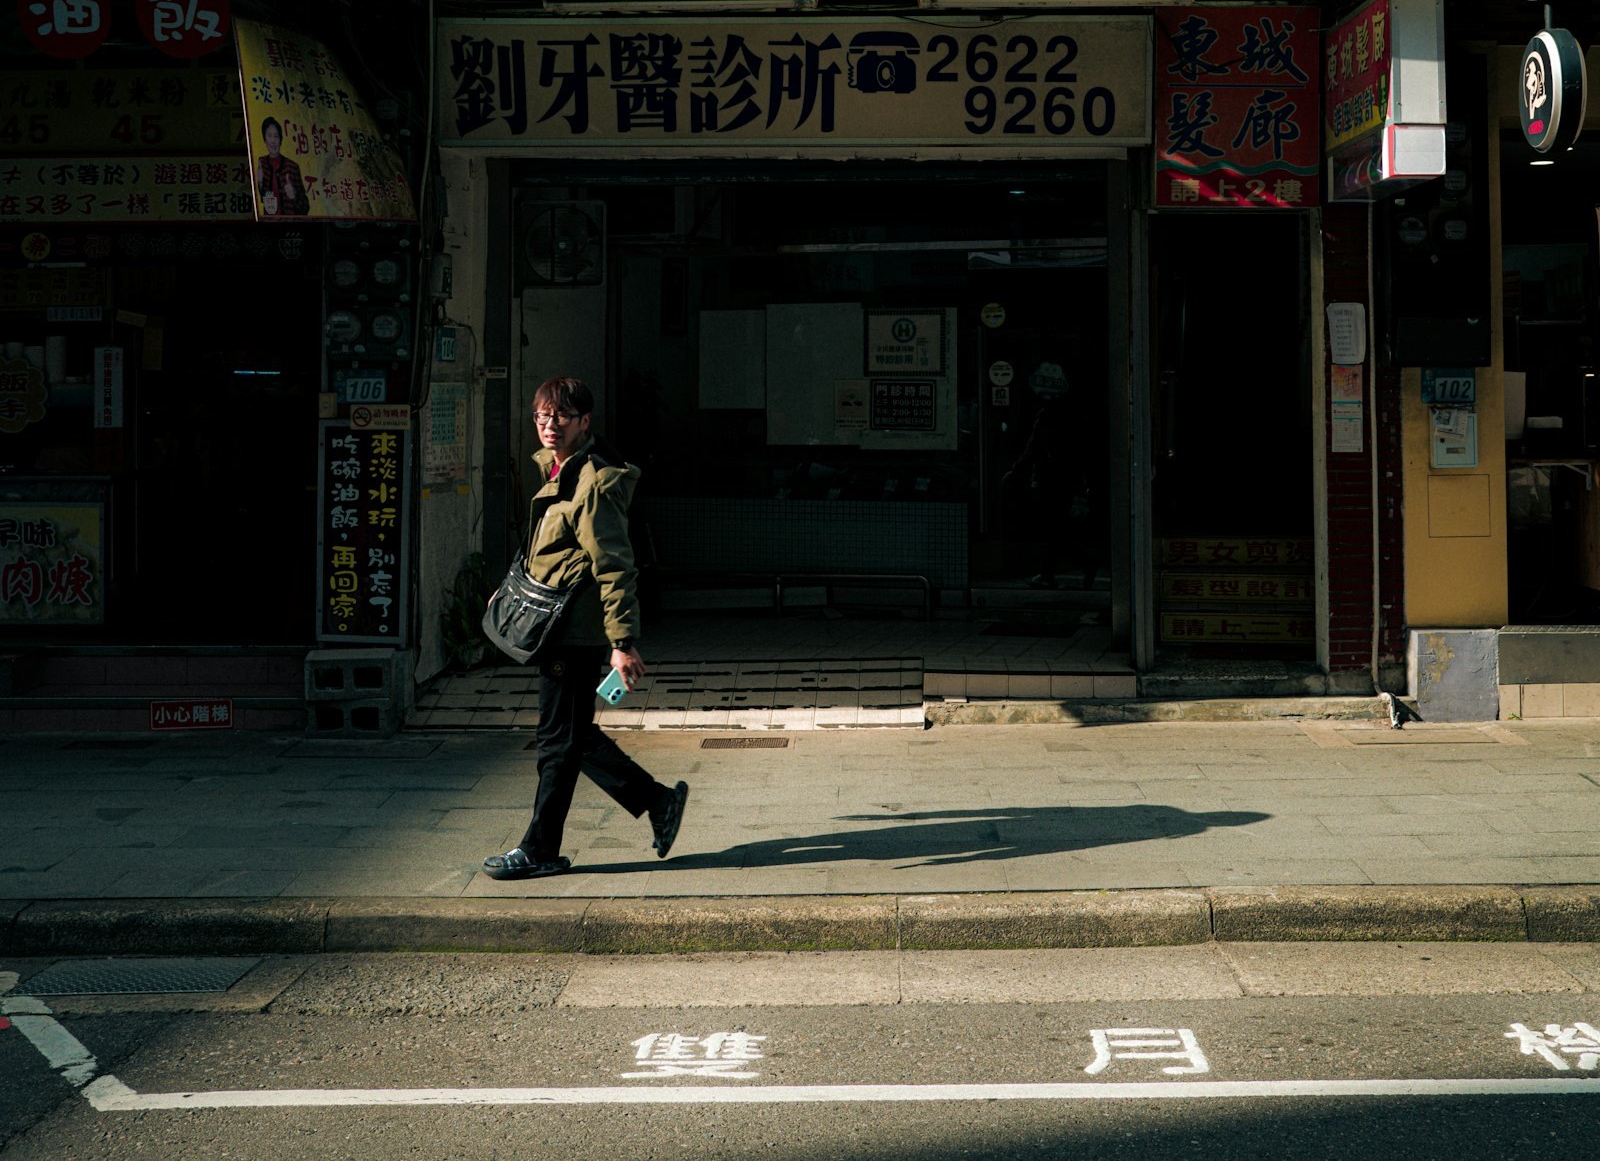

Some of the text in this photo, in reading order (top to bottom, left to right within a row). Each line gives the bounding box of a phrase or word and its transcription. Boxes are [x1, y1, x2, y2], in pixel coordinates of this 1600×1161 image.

[925, 33, 1079, 84] 2622
[1167, 15, 1310, 83] 東城
[450, 32, 843, 137] 劉牙醫診所
[109, 114, 165, 144] 45
[963, 85, 1116, 136] 9260
[1167, 90, 1302, 160] 髮廊
[1169, 179, 1304, 204] 請上2樓
[350, 381, 383, 400] 106
[876, 385, 931, 397] 門診時間
[1439, 379, 1472, 399] 102
[154, 704, 229, 724] 小心階梯
[1083, 1027, 1211, 1075] 月
